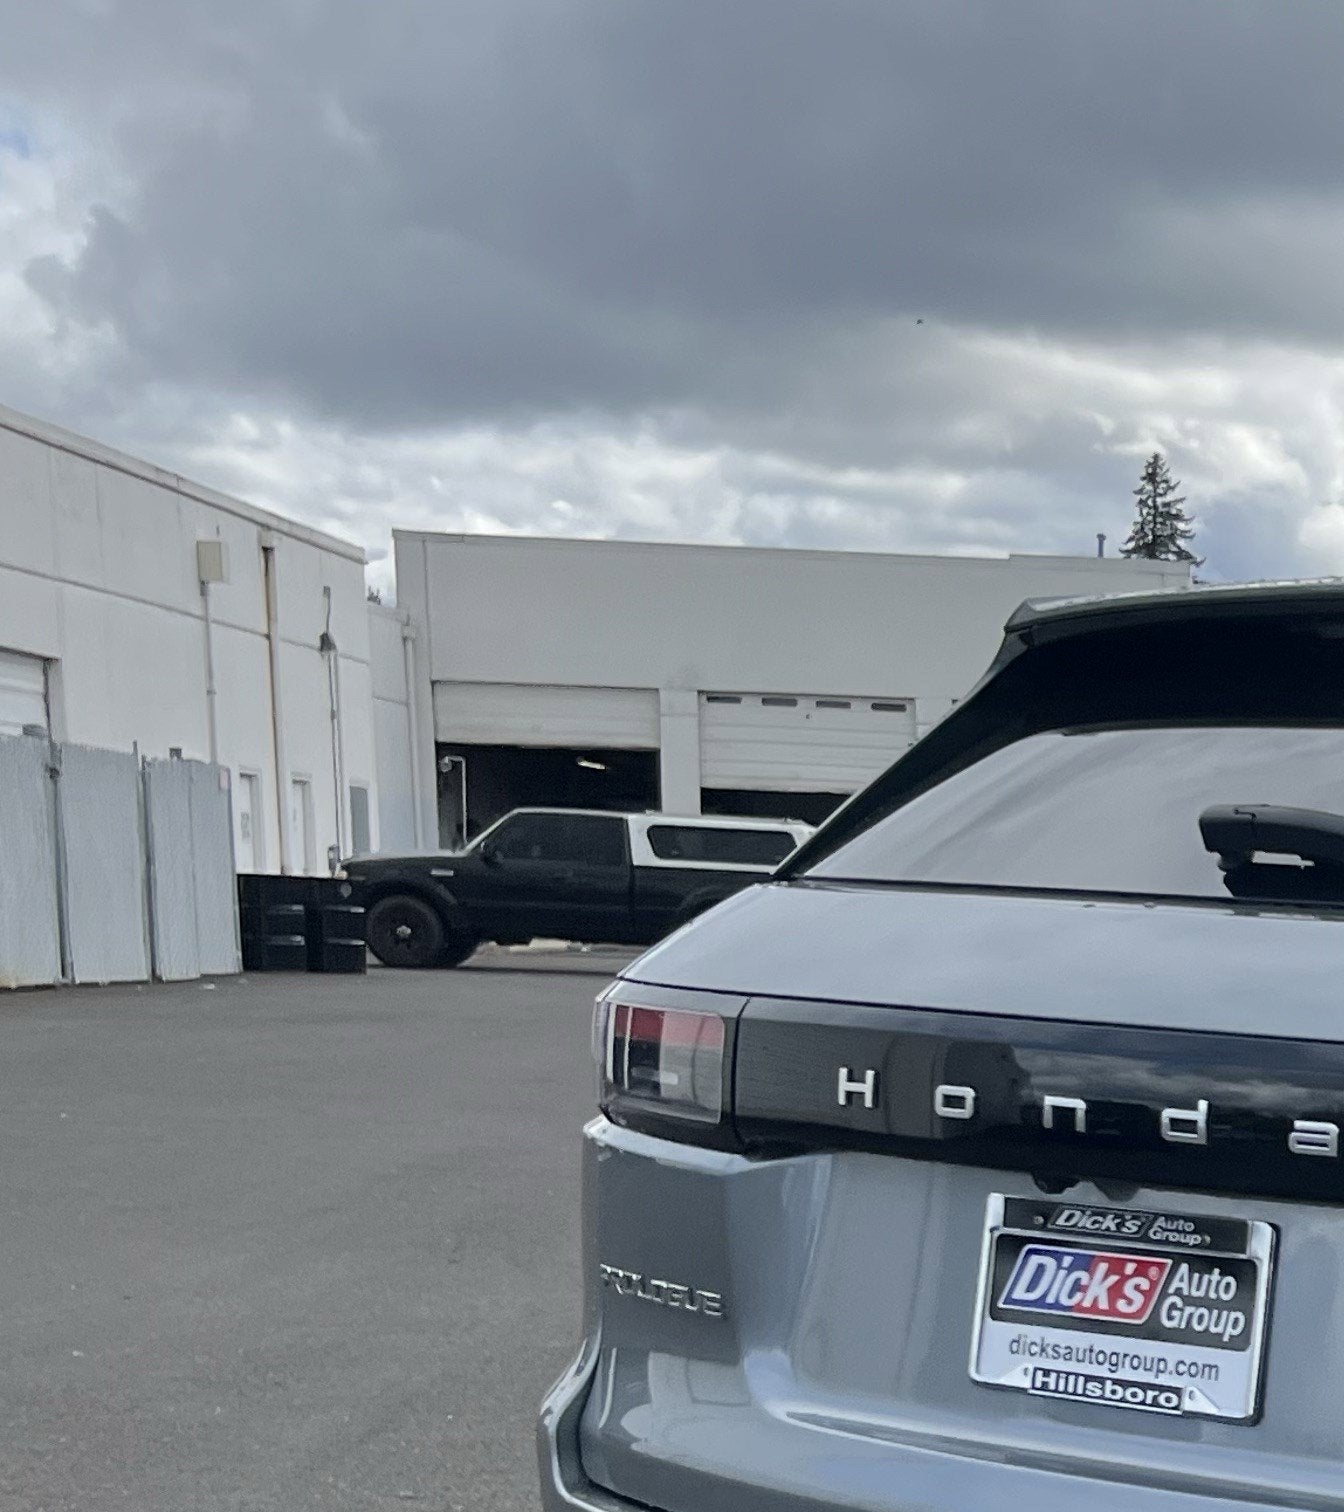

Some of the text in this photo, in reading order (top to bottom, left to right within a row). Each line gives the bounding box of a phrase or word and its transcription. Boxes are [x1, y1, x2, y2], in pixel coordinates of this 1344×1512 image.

[838, 1067, 1339, 1157] Honda
[1055, 1209, 1142, 1233] Dick's
[1148, 1227, 1202, 1246] Group
[1152, 1216, 1195, 1232] Auto
[1011, 1254, 1150, 1314] Dick's
[1168, 1263, 1238, 1301] Auto
[1160, 1295, 1246, 1342] Group
[1008, 1334, 1220, 1381] dicksautogroup.com
[1034, 1370, 1182, 1408] Hillsboro
